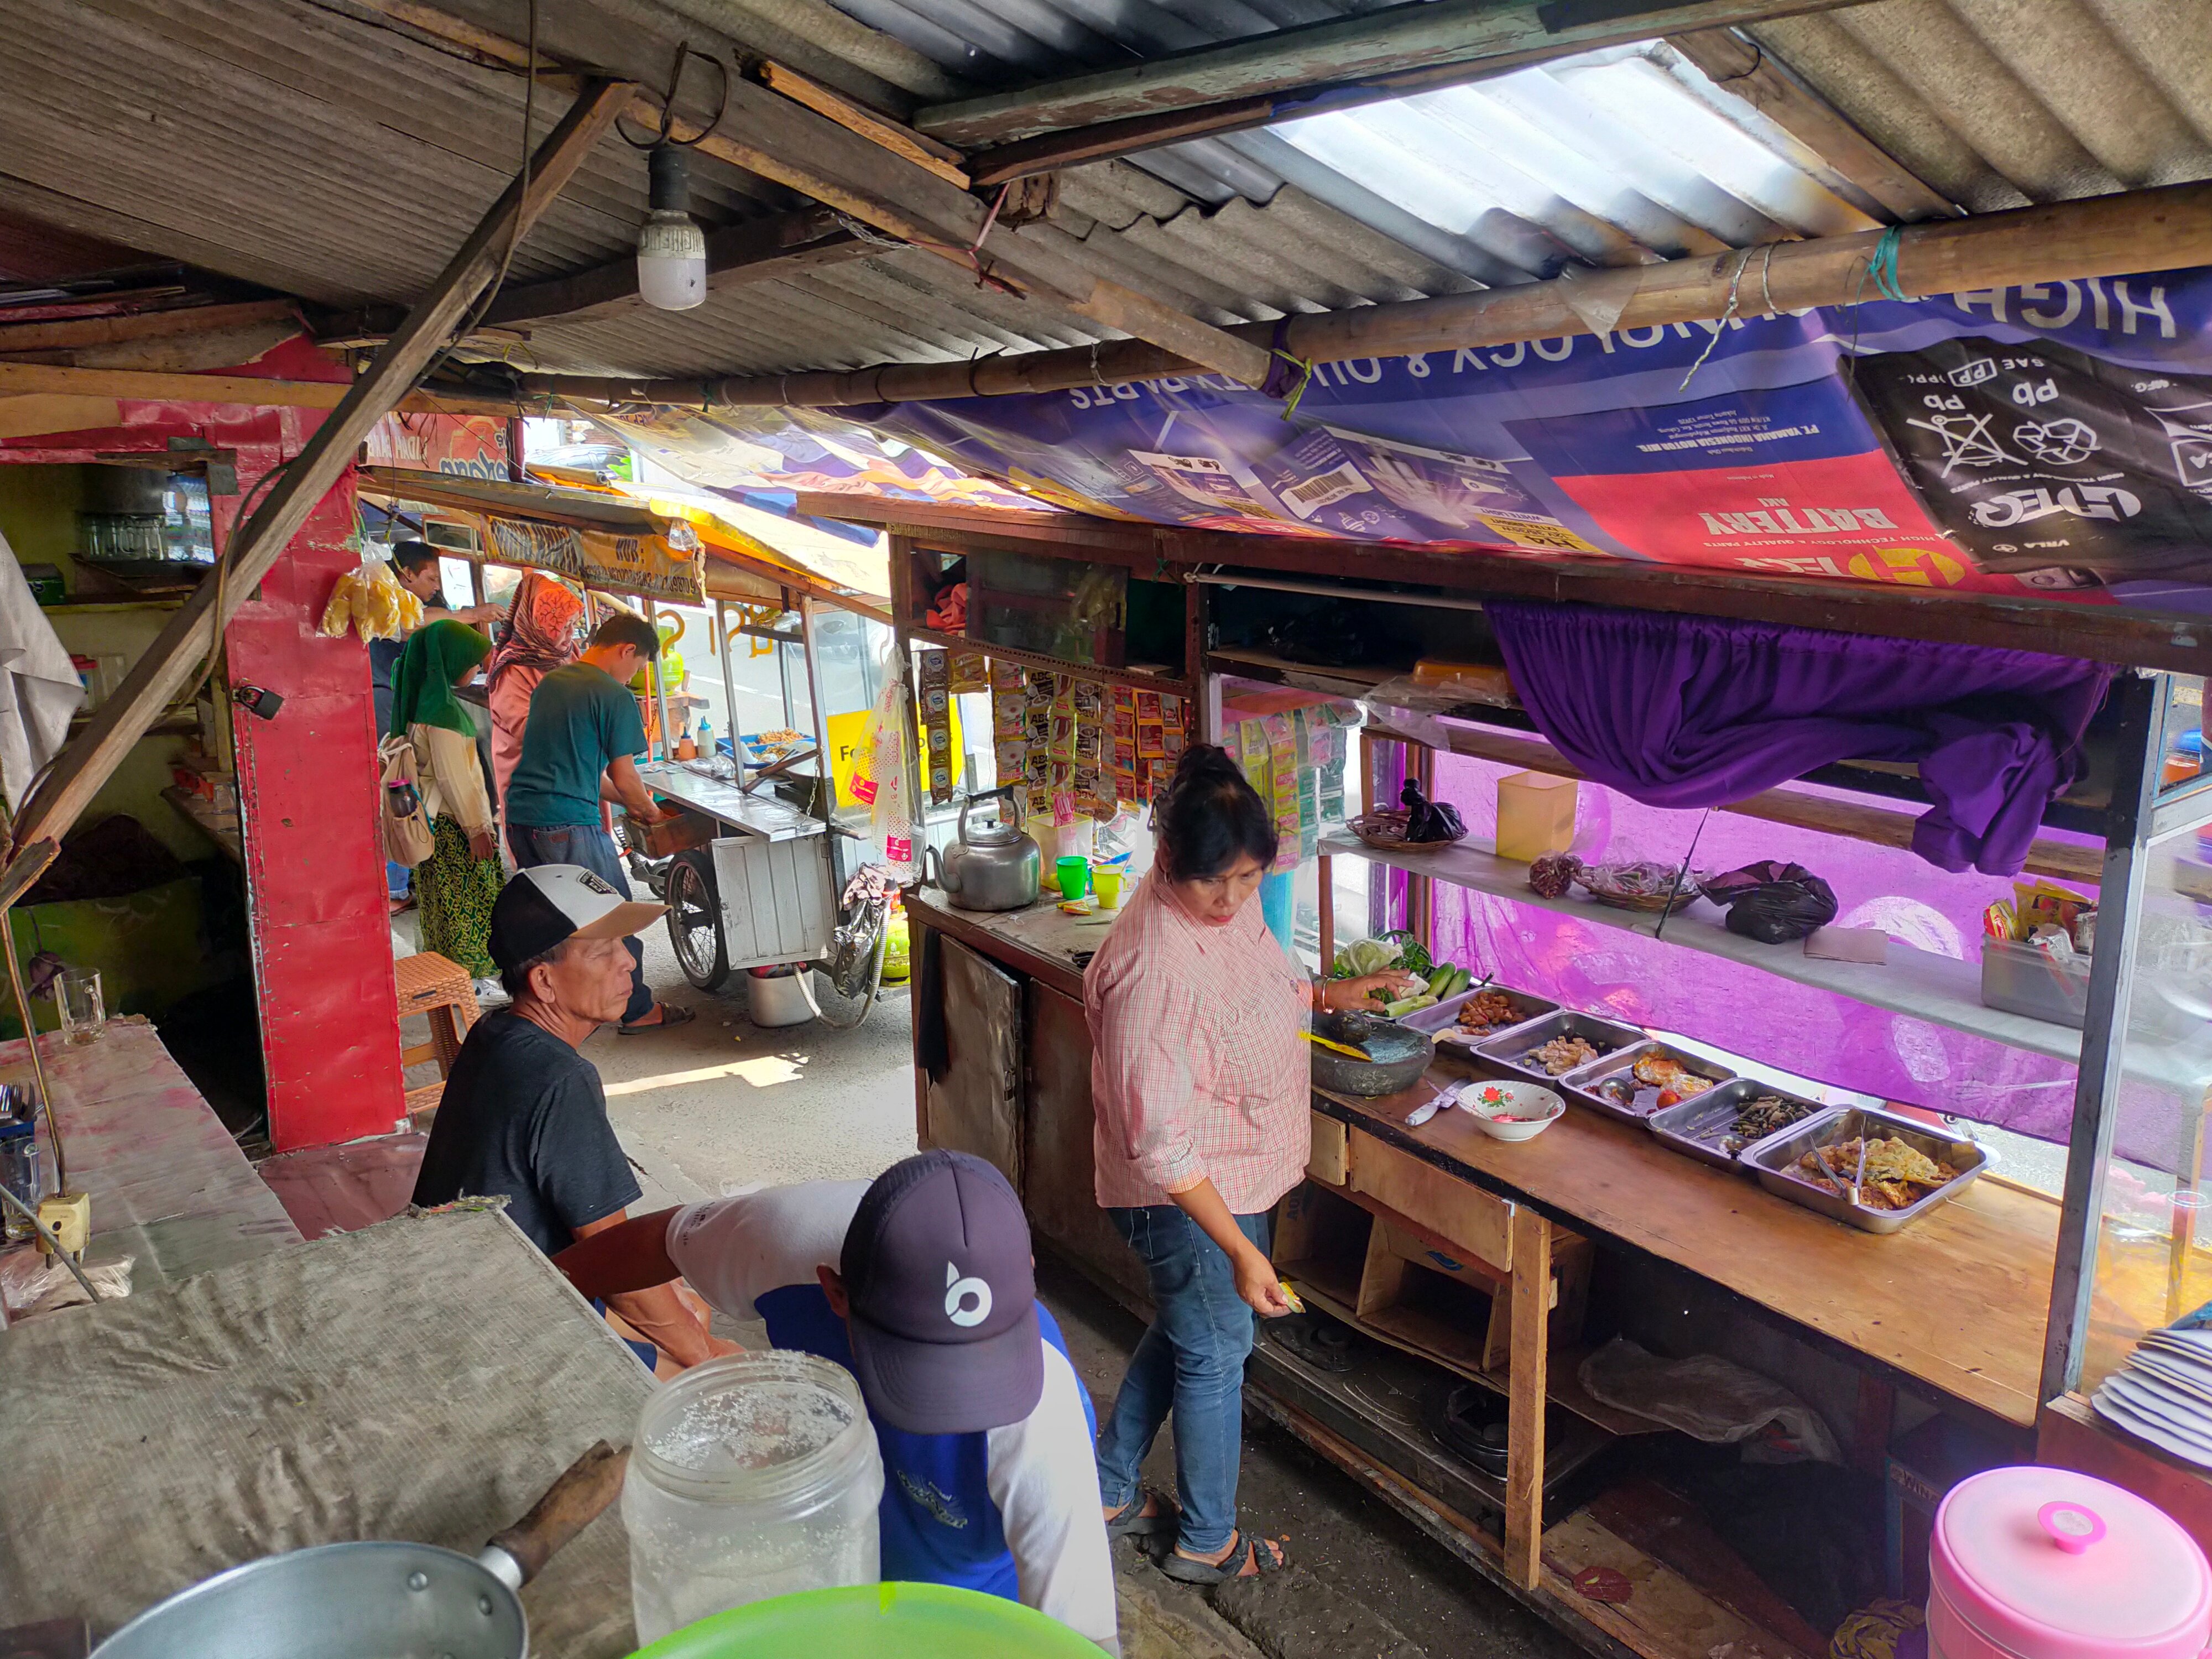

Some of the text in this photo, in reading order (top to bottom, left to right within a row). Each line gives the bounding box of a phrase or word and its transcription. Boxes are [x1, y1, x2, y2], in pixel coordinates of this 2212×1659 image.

[2002, 358, 2045, 369] SAE
[1959, 365, 1986, 384] PP
[1923, 378, 2059, 410] Pb Pb
[1754, 427, 1802, 442] YAMAHA
[1801, 425, 1820, 436] PT.
[1661, 440, 1699, 450] MOTOR
[1700, 434, 1754, 447] INDONESIA
[1790, 498, 1812, 507] AKI
[1480, 508, 1544, 521] WHITE LIGHT
[1698, 508, 1899, 535] BATTERY
[1524, 536, 1582, 550] H4
[1809, 536, 1897, 546] TECHNOLOGY
[2023, 539, 2070, 548] VRLA
[1030, 671, 1051, 682] ABC
